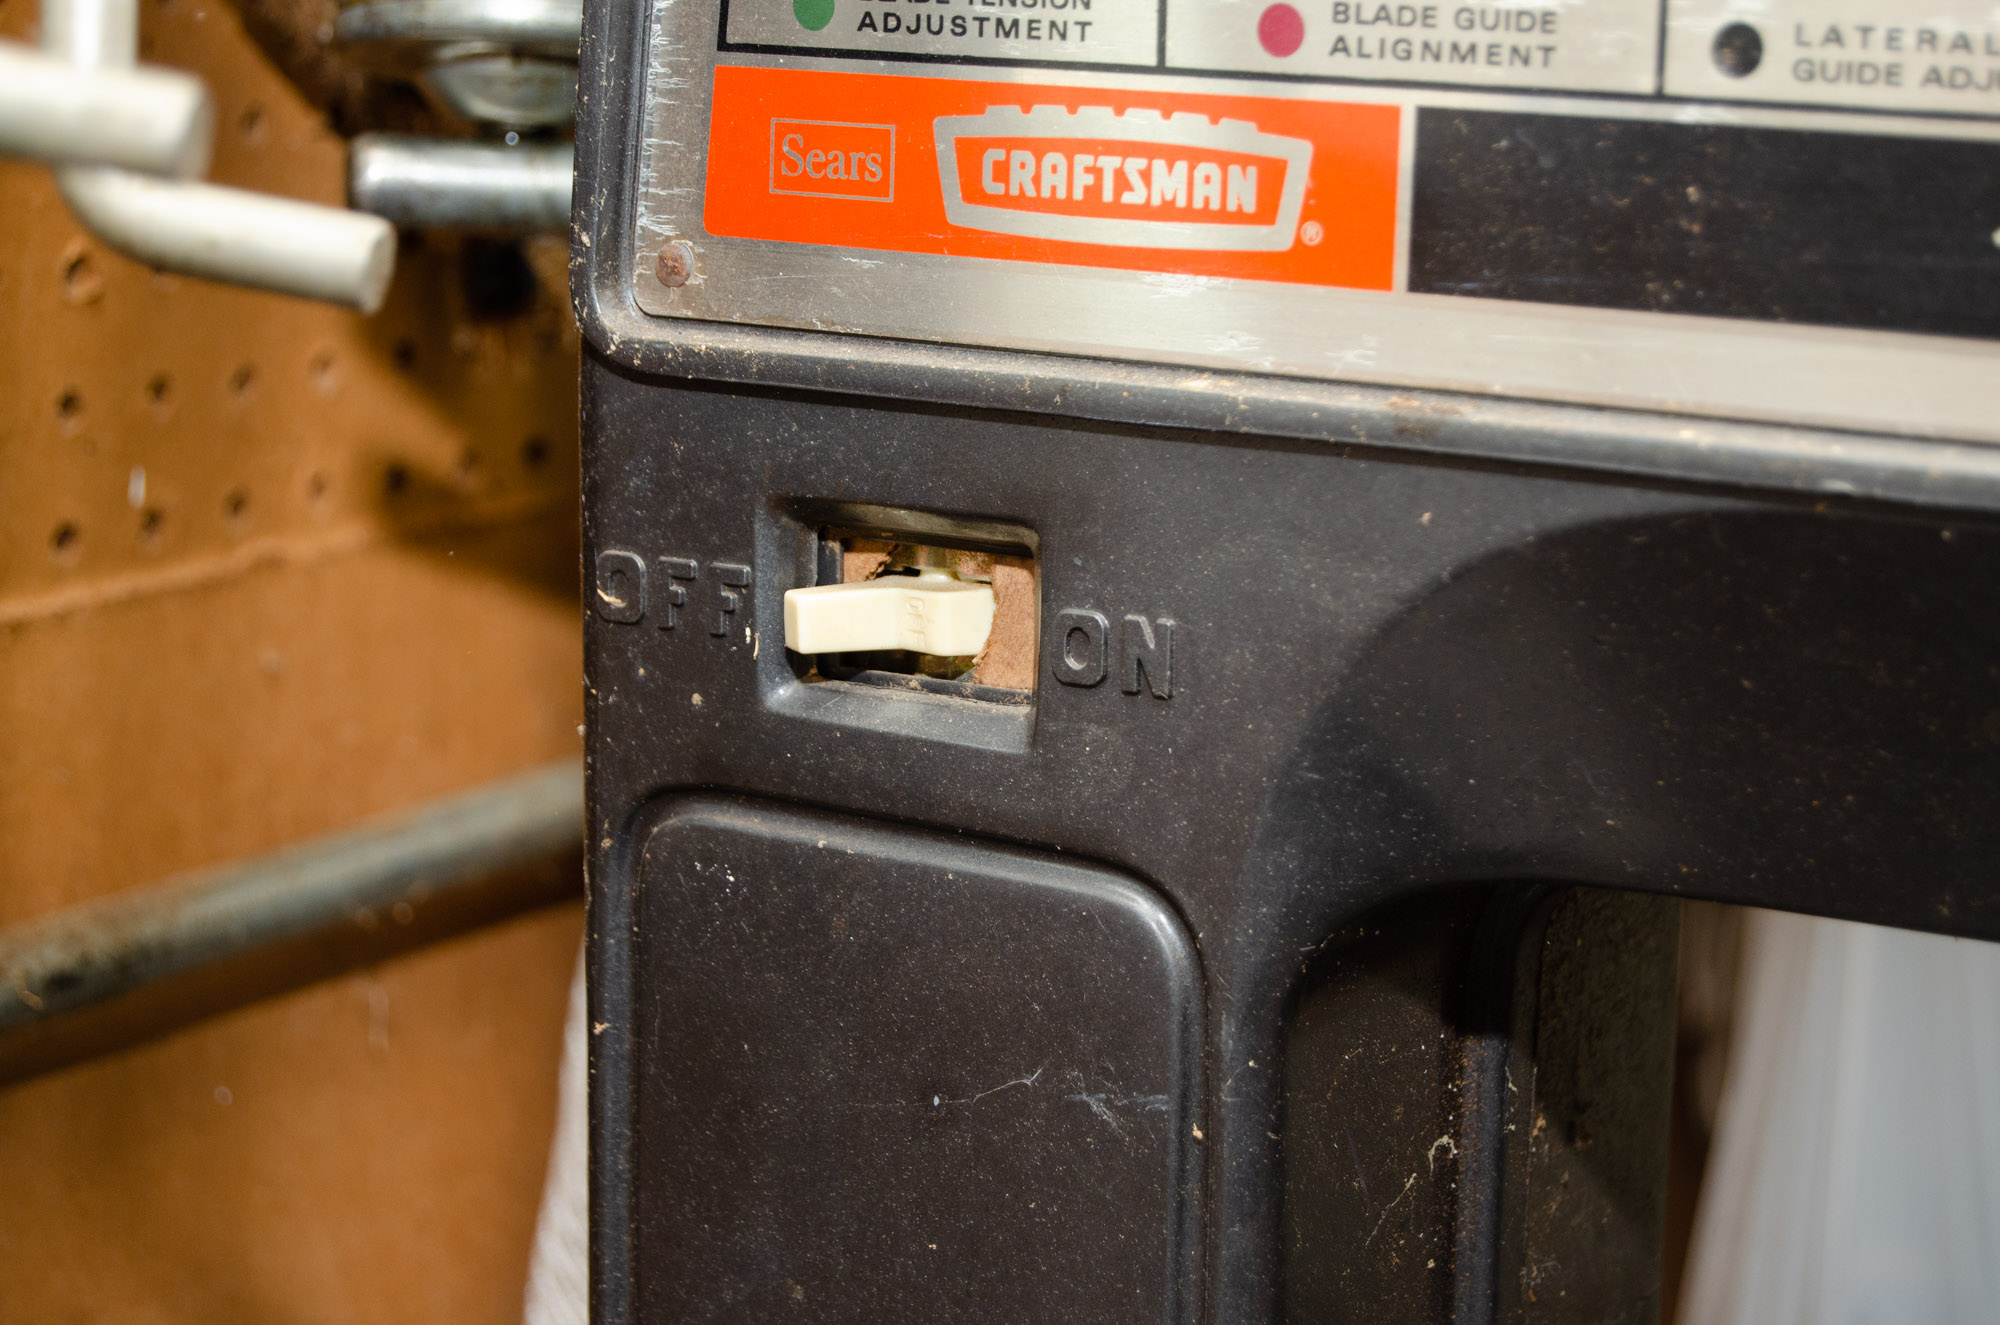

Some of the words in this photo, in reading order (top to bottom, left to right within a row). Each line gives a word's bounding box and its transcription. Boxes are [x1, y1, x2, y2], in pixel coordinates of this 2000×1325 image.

[857, 11, 1093, 42] ADJUSTMENT
[1332, 2, 1438, 28] BLADE
[1454, 7, 1557, 34] GUIDE
[1329, 35, 1557, 68] ALIGNMENT
[1795, 23, 2000, 56] LATERAL
[1793, 58, 1903, 87] GUIDE
[781, 134, 883, 183] Sears
[981, 148, 1257, 213] CRAFTSMAN
[596, 550, 752, 638] OFF
[1051, 607, 1176, 700] ON
